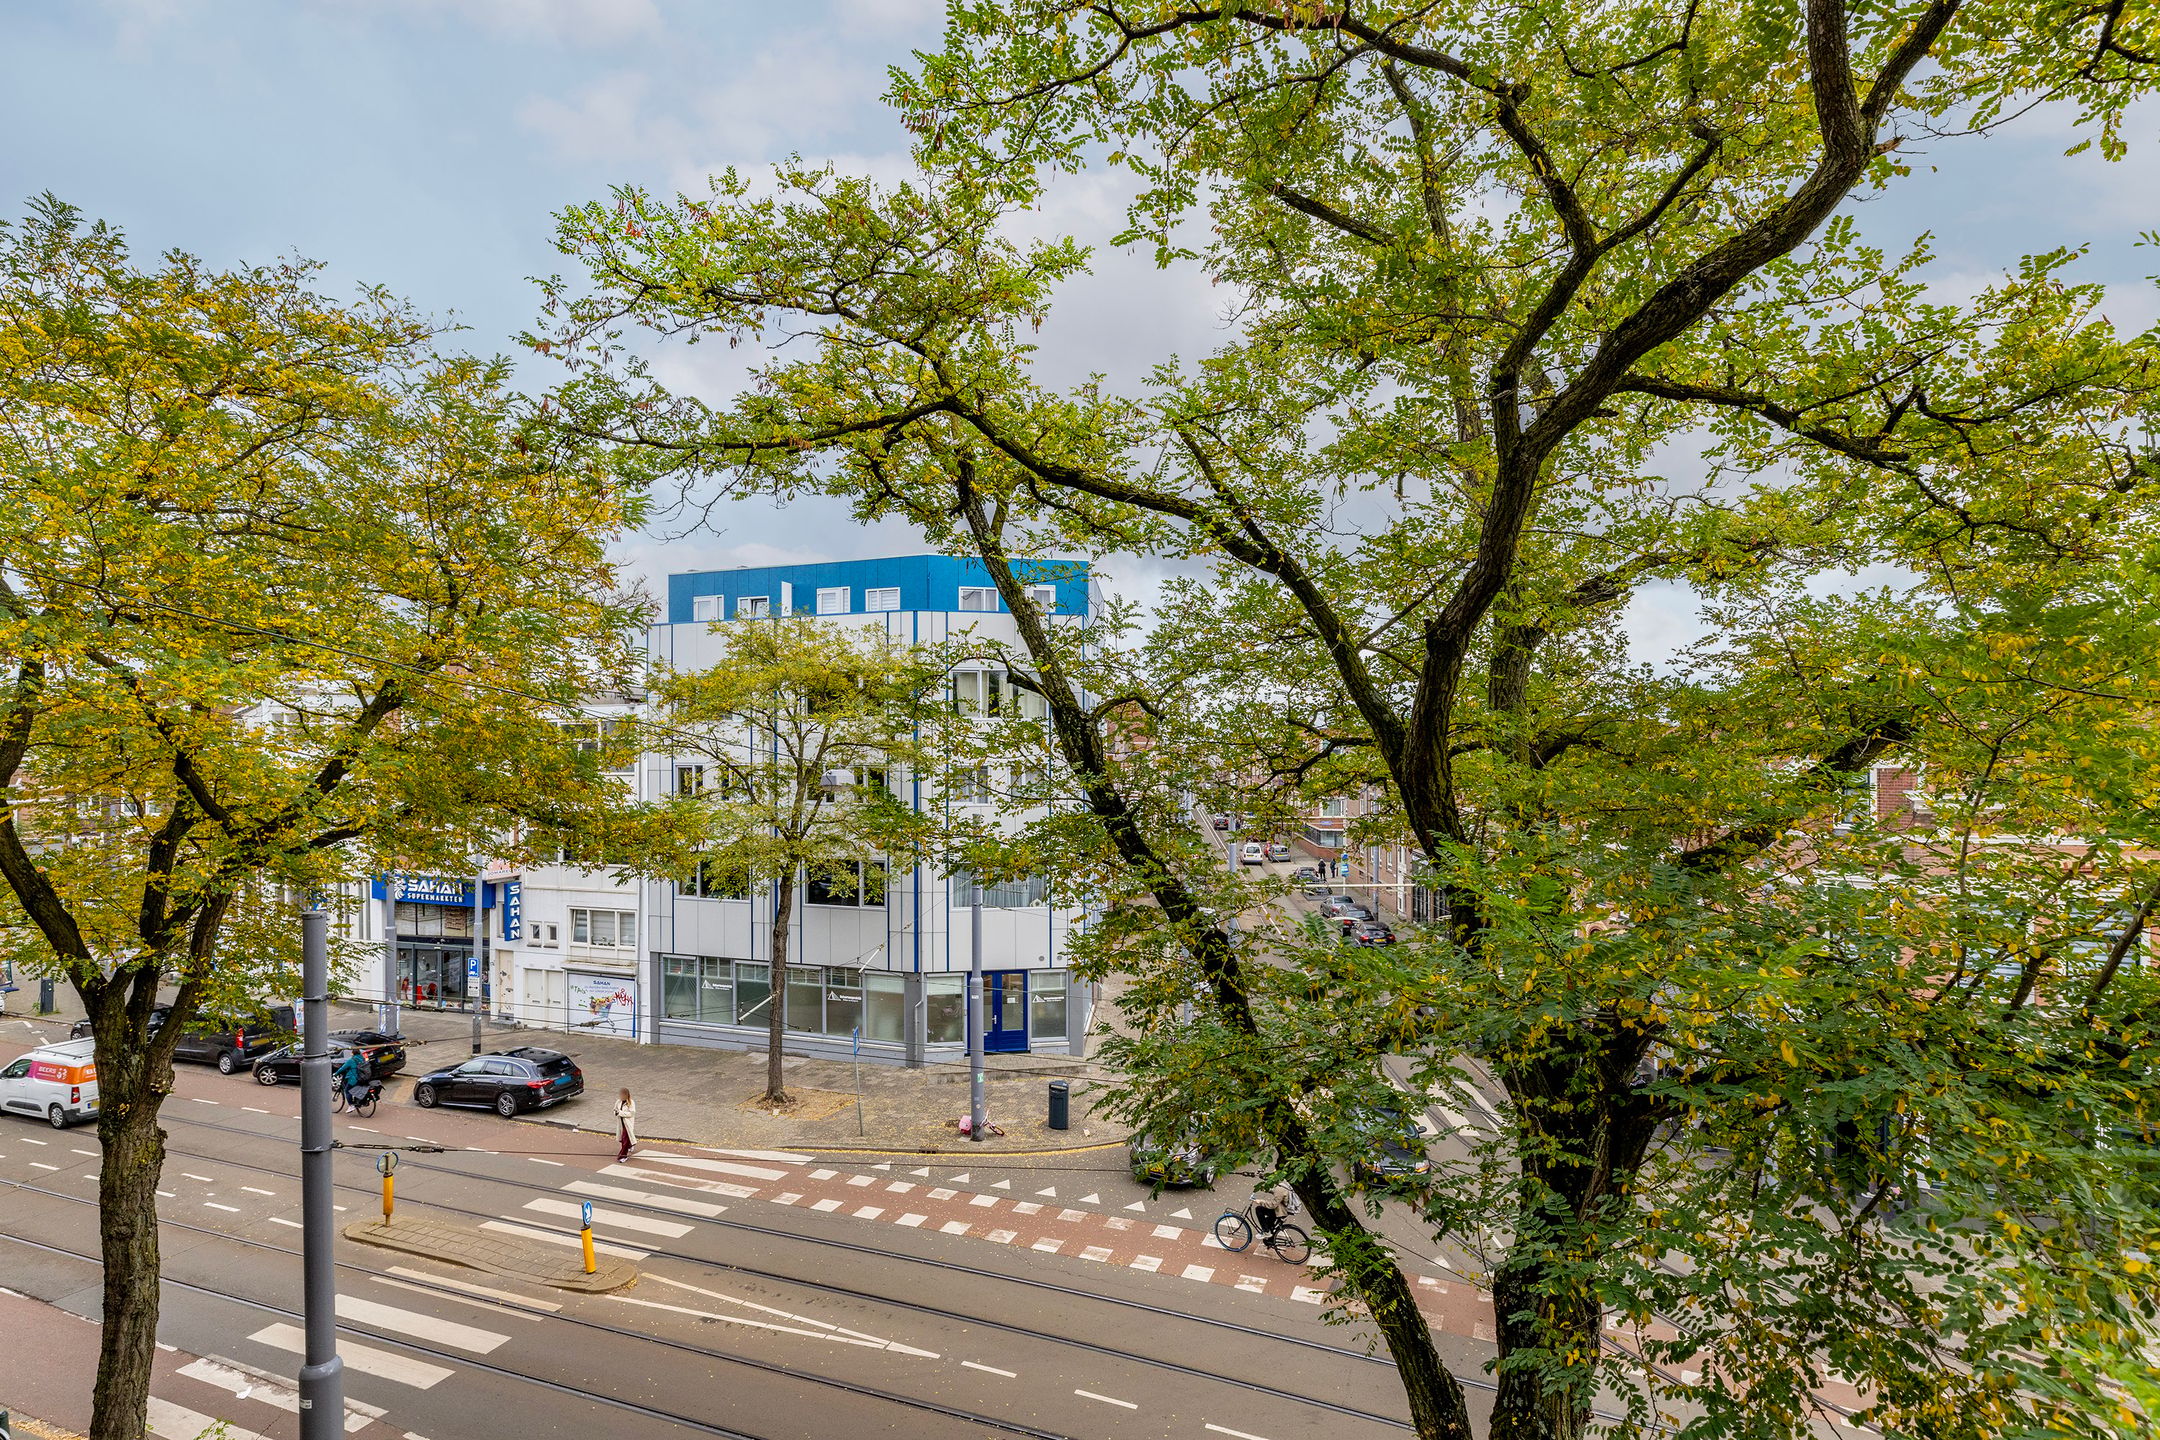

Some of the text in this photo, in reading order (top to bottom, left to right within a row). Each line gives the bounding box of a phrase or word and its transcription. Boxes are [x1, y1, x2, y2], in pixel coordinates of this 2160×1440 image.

[407, 879, 463, 895] SAHAN
[407, 892, 463, 903] SUPERMARKTEN
[509, 885, 520, 939] SAHAN
[470, 960, 477, 970] P
